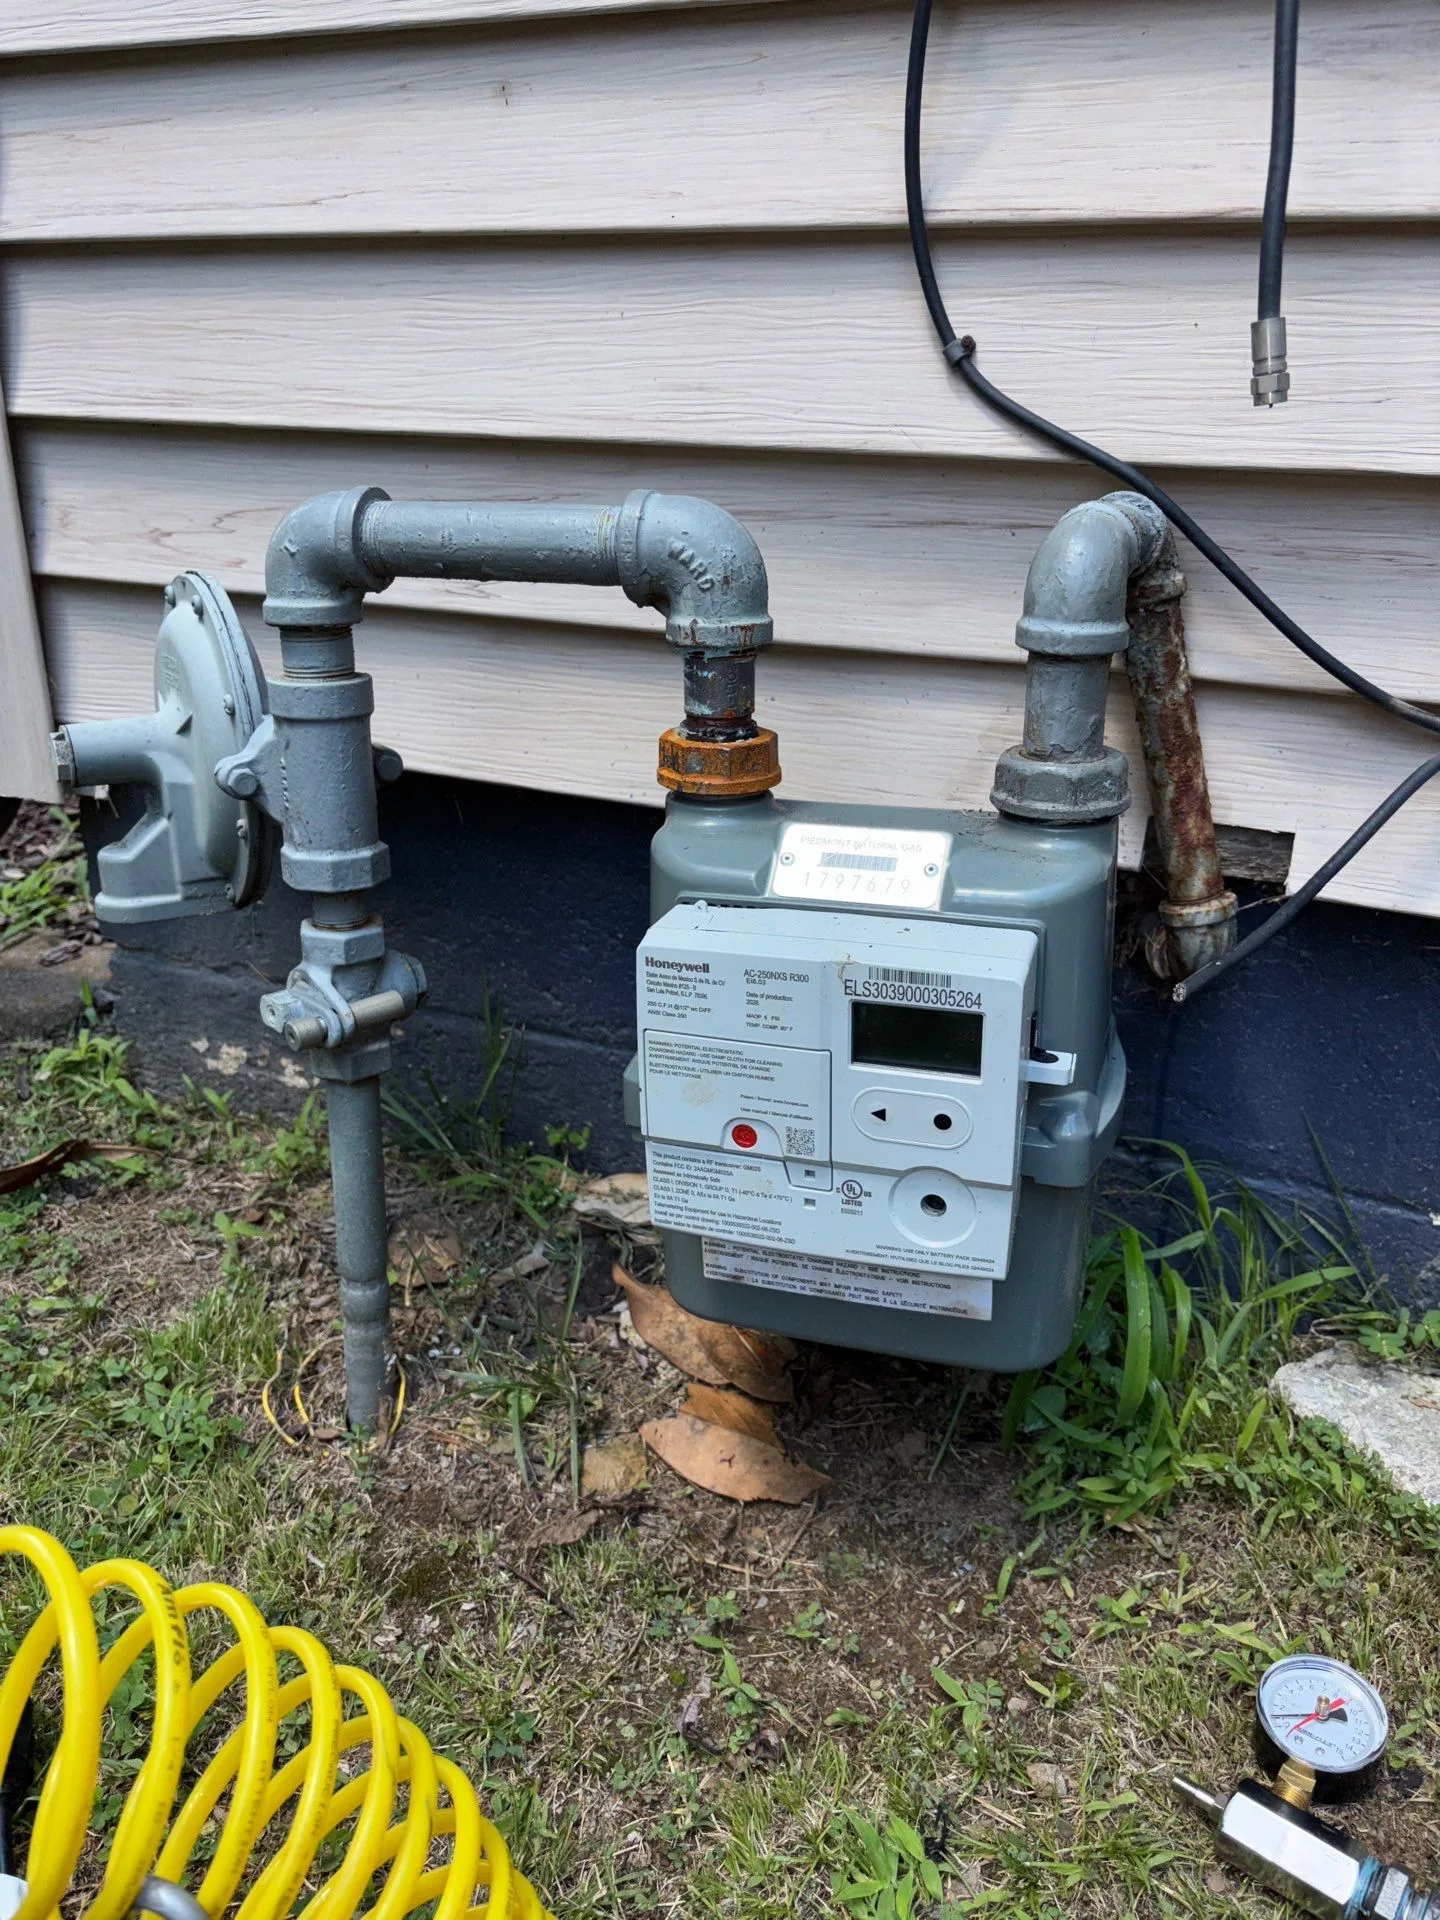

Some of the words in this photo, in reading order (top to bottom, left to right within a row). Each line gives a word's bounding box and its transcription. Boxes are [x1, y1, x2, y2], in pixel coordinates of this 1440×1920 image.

[668, 541, 715, 592] WARD
[800, 836, 851, 847] PIEDMONT
[853, 842, 898, 852] NATURAL
[902, 844, 923, 853] GAS
[803, 872, 911, 893] 1797679
[645, 956, 710, 974] Honeywell
[744, 968, 788, 981] AC-250NXS
[789, 973, 810, 984] R300
[844, 979, 982, 1009] ELS3039000305264
[674, 1043, 701, 1051] POTENTIAL
[703, 1046, 744, 1056] ELECTROSTATIC
[649, 1047, 675, 1055] CHARGING
[756, 1059, 783, 1067] CLEANING
[663, 1153, 681, 1161] product
[653, 1160, 673, 1168] Contains
[675, 1180, 698, 1188] DIVISION
[705, 1184, 724, 1192] GROUP
[841, 1198, 862, 1206] LISTED
[685, 1206, 709, 1215] Equipment
[732, 1212, 758, 1222] Hazardous
[759, 1216, 782, 1225] Locations
[930, 1251, 955, 1259] BATTERY
[881, 1291, 903, 1299] SAFETY
[1349, 1708, 1358, 1716] 10
[1355, 1729, 1364, 1737] 12
[1351, 1736, 1361, 1744] 13
[1335, 1747, 1343, 1755] 15
